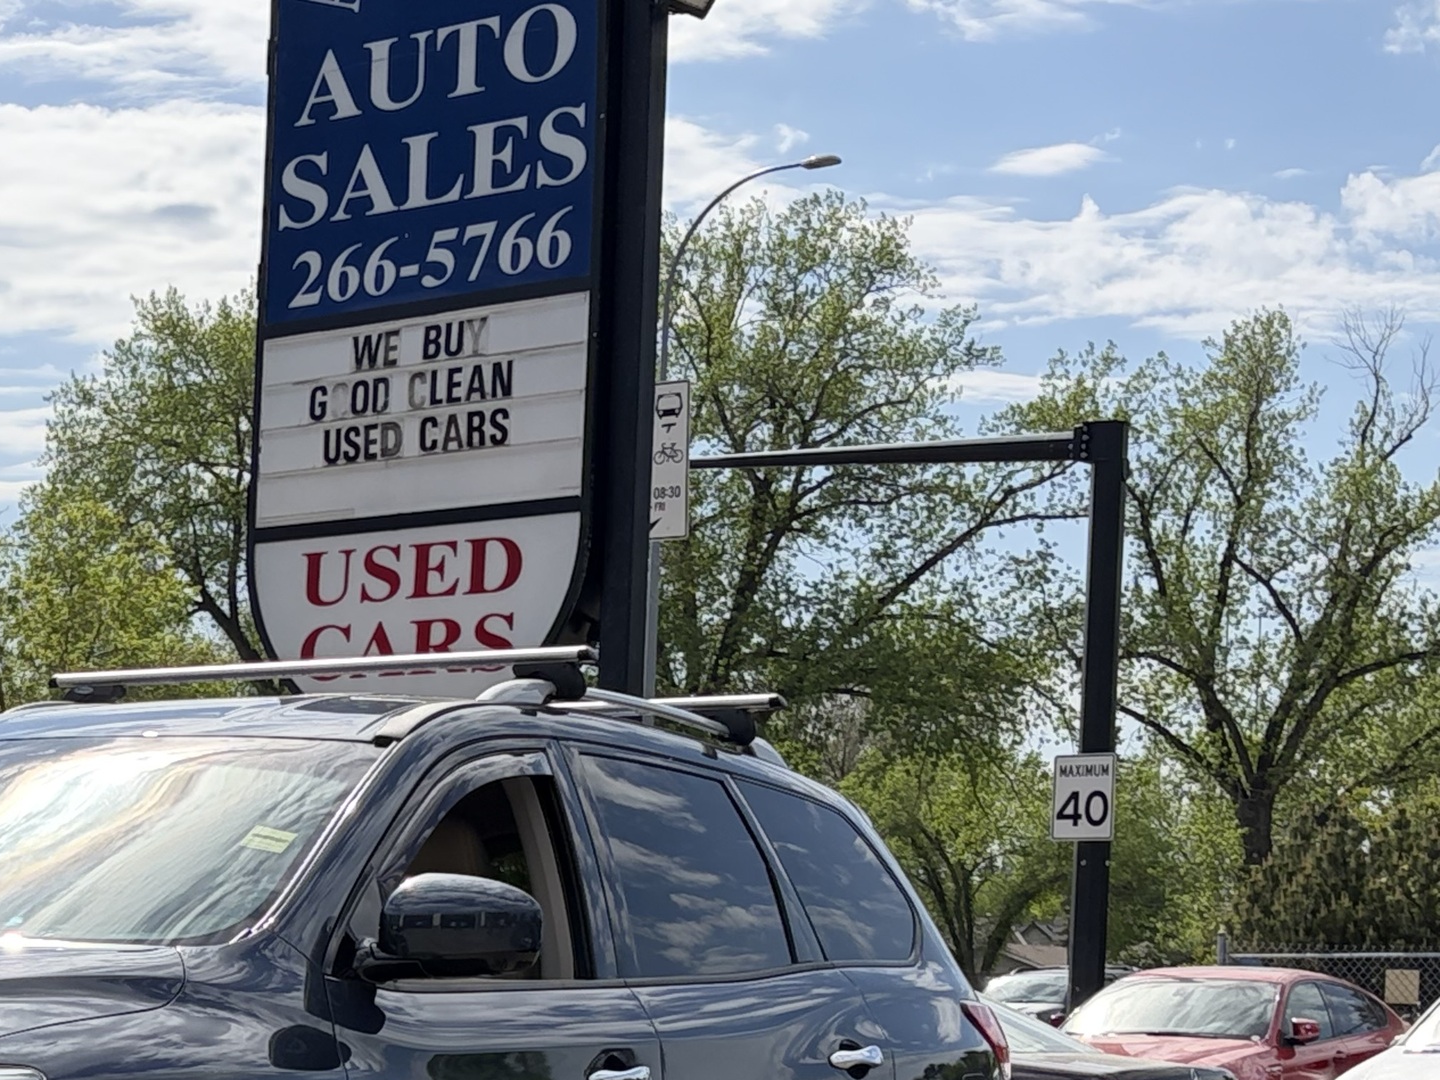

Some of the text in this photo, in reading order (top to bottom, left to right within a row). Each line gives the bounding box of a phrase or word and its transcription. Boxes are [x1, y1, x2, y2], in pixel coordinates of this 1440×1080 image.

[294, 3, 578, 127] AUTO
[278, 102, 588, 232] SALES
[288, 205, 574, 309] 266-5766
[352, 316, 489, 371] WE BUY
[408, 360, 514, 411] CLEAN
[323, 408, 510, 465] USED CARS
[301, 537, 523, 607] USED
[300, 612, 515, 682] CARS
[1059, 764, 1110, 778] MAXIMUM
[1056, 790, 1109, 828] 40
